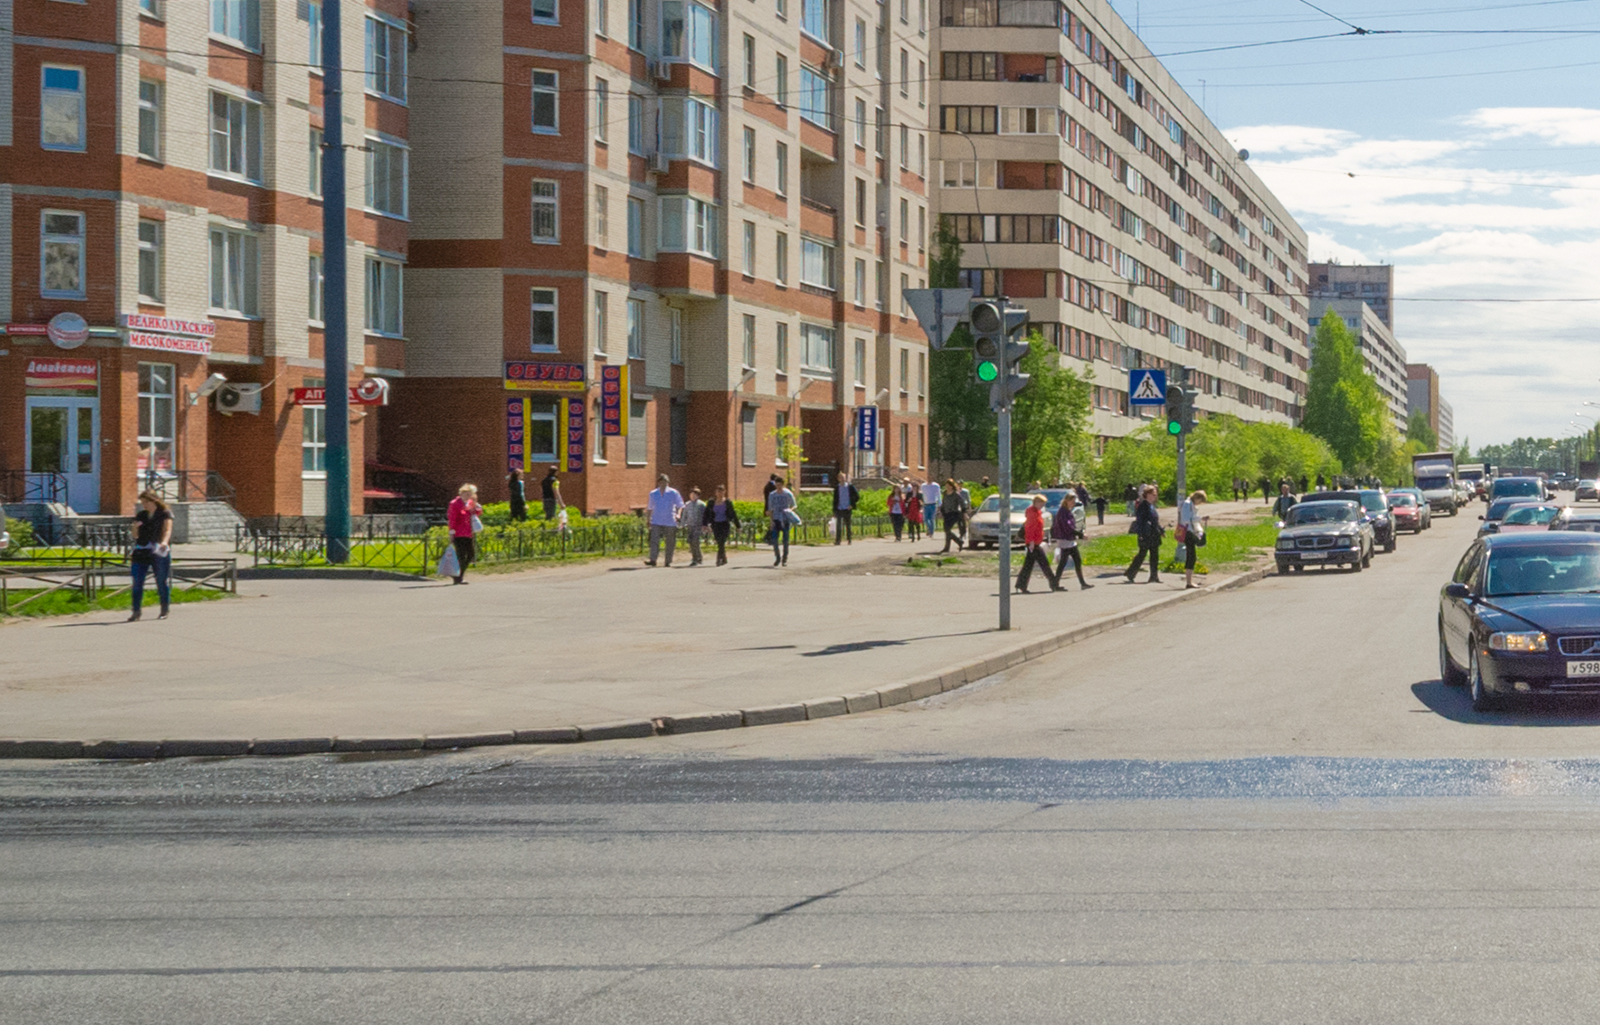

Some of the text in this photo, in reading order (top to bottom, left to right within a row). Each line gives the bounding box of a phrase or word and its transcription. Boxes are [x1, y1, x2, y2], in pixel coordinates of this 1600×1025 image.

[128, 314, 215, 335] ВЕЛИКОЛУКСКИЙ
[131, 333, 211, 353] МЯСОКОМБИНАТ
[508, 363, 582, 379] ОБУВЬ
[604, 367, 619, 433] ОБУВЬ
[509, 402, 523, 469] ОБУВЬ
[569, 402, 583, 469] ОБУВЬ
[863, 408, 872, 449] МЕБЕЛЬ
